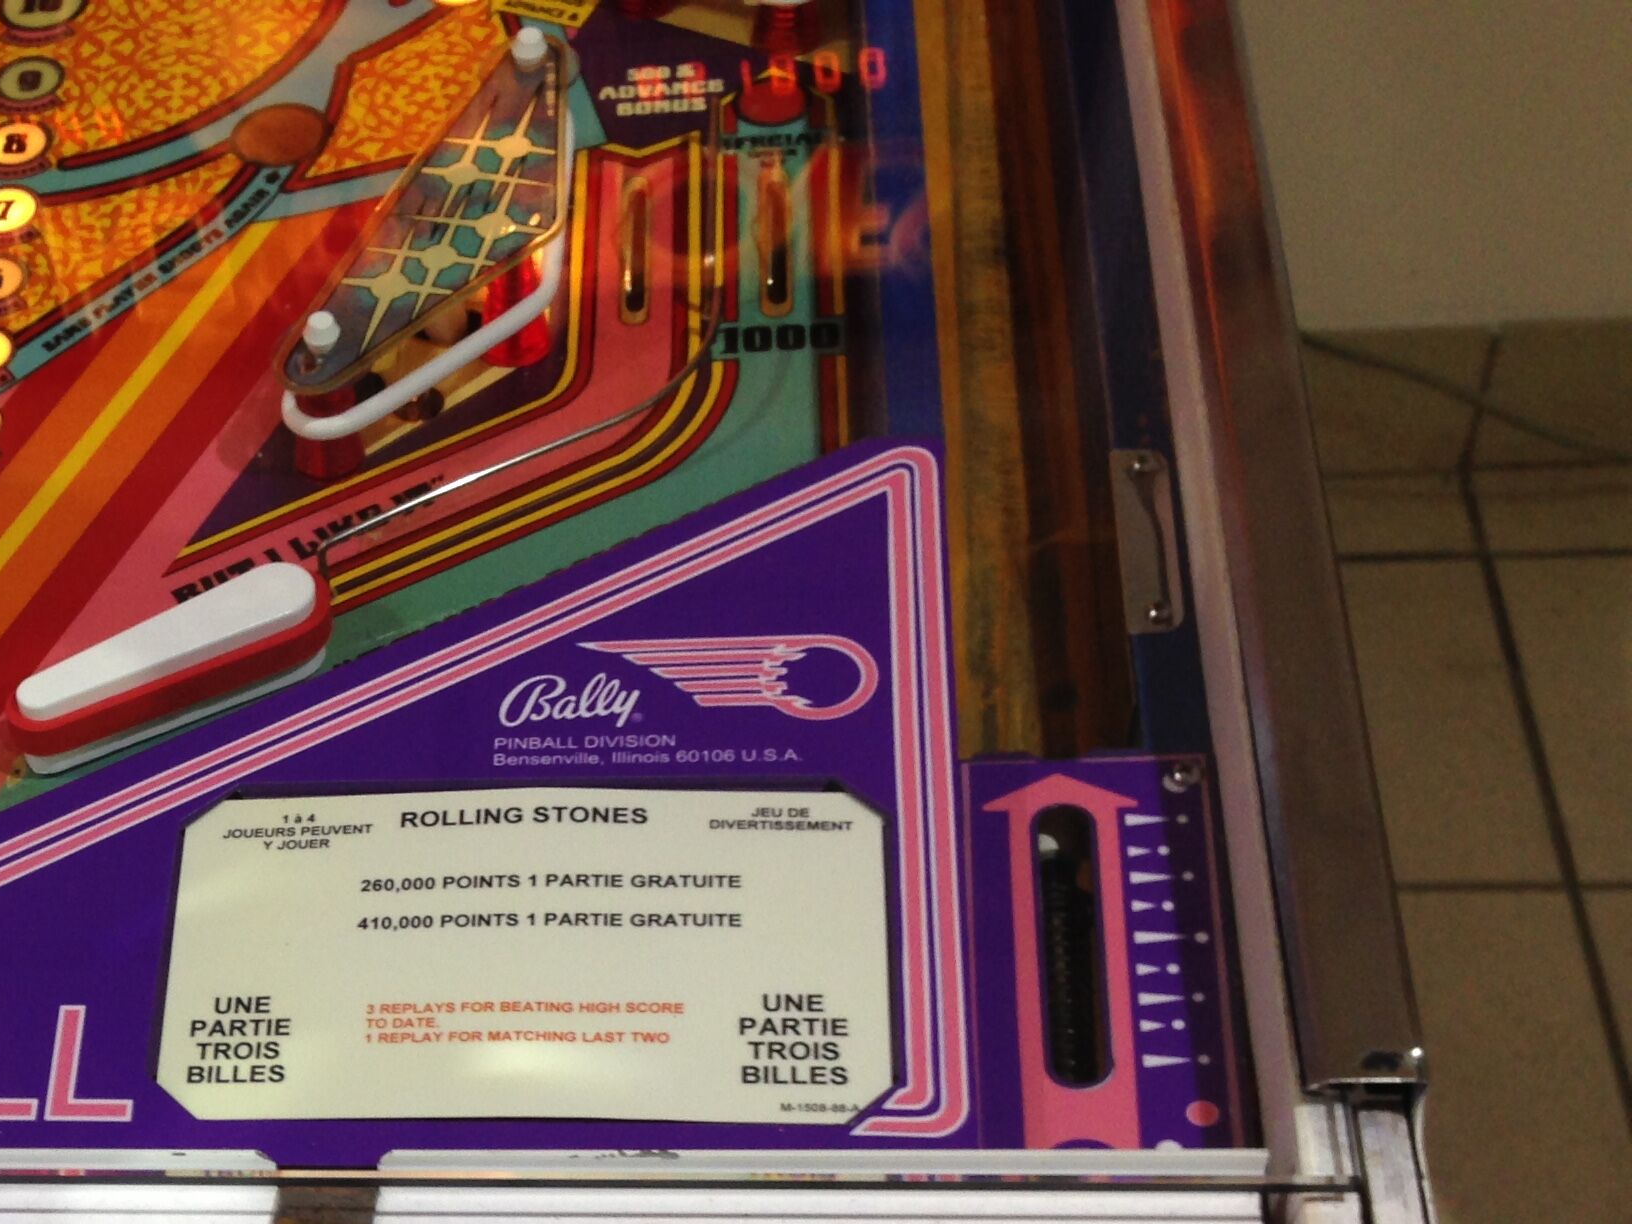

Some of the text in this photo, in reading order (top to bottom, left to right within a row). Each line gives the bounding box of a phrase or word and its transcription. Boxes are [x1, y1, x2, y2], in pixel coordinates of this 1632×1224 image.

[616, 97, 707, 116] BONUS
[720, 324, 840, 352] 1000
[498, 673, 641, 728] Bally
[493, 734, 677, 750] PINBALL DIVISION
[492, 749, 804, 766] Bensenville, Illinois 60106 U.S.A.
[400, 805, 649, 827] ROLLING STONES
[751, 806, 811, 818] JEU DE
[223, 823, 374, 839] JOUEURS PEUVENT
[709, 819, 854, 831] DIVERTISSEMENT
[263, 838, 330, 850] Y JOUER
[360, 876, 436, 892] 260,000
[442, 873, 521, 889] POINTS
[545, 873, 624, 888] PARTIE
[630, 874, 743, 889] GRATUITE
[357, 914, 434, 931] 410,000
[440, 912, 520, 928] POINTS
[543, 912, 623, 927] PARTIE
[630, 912, 743, 928] GRATUITE
[214, 995, 272, 1014] UNE
[379, 1003, 456, 1015] REPLAYS
[461, 1002, 494, 1013] FOR
[499, 1002, 574, 1013] BEATING
[578, 1002, 619, 1013] HIGH
[625, 1002, 685, 1014] SCORE
[762, 993, 824, 1013] UNE
[189, 1018, 292, 1037] PARTIE
[366, 1017, 388, 1029] TO
[738, 1017, 849, 1036] PARTIE
[378, 1032, 442, 1044] REPLAY
[448, 1031, 482, 1043] FOR
[487, 1030, 576, 1042] MATCHING
[581, 1031, 626, 1043] LAST
[631, 1031, 670, 1044] TWO
[196, 1041, 280, 1060] TROIS
[747, 1041, 840, 1061] TROIS
[186, 1064, 286, 1084] BILLES
[741, 1065, 849, 1085] BILLES
